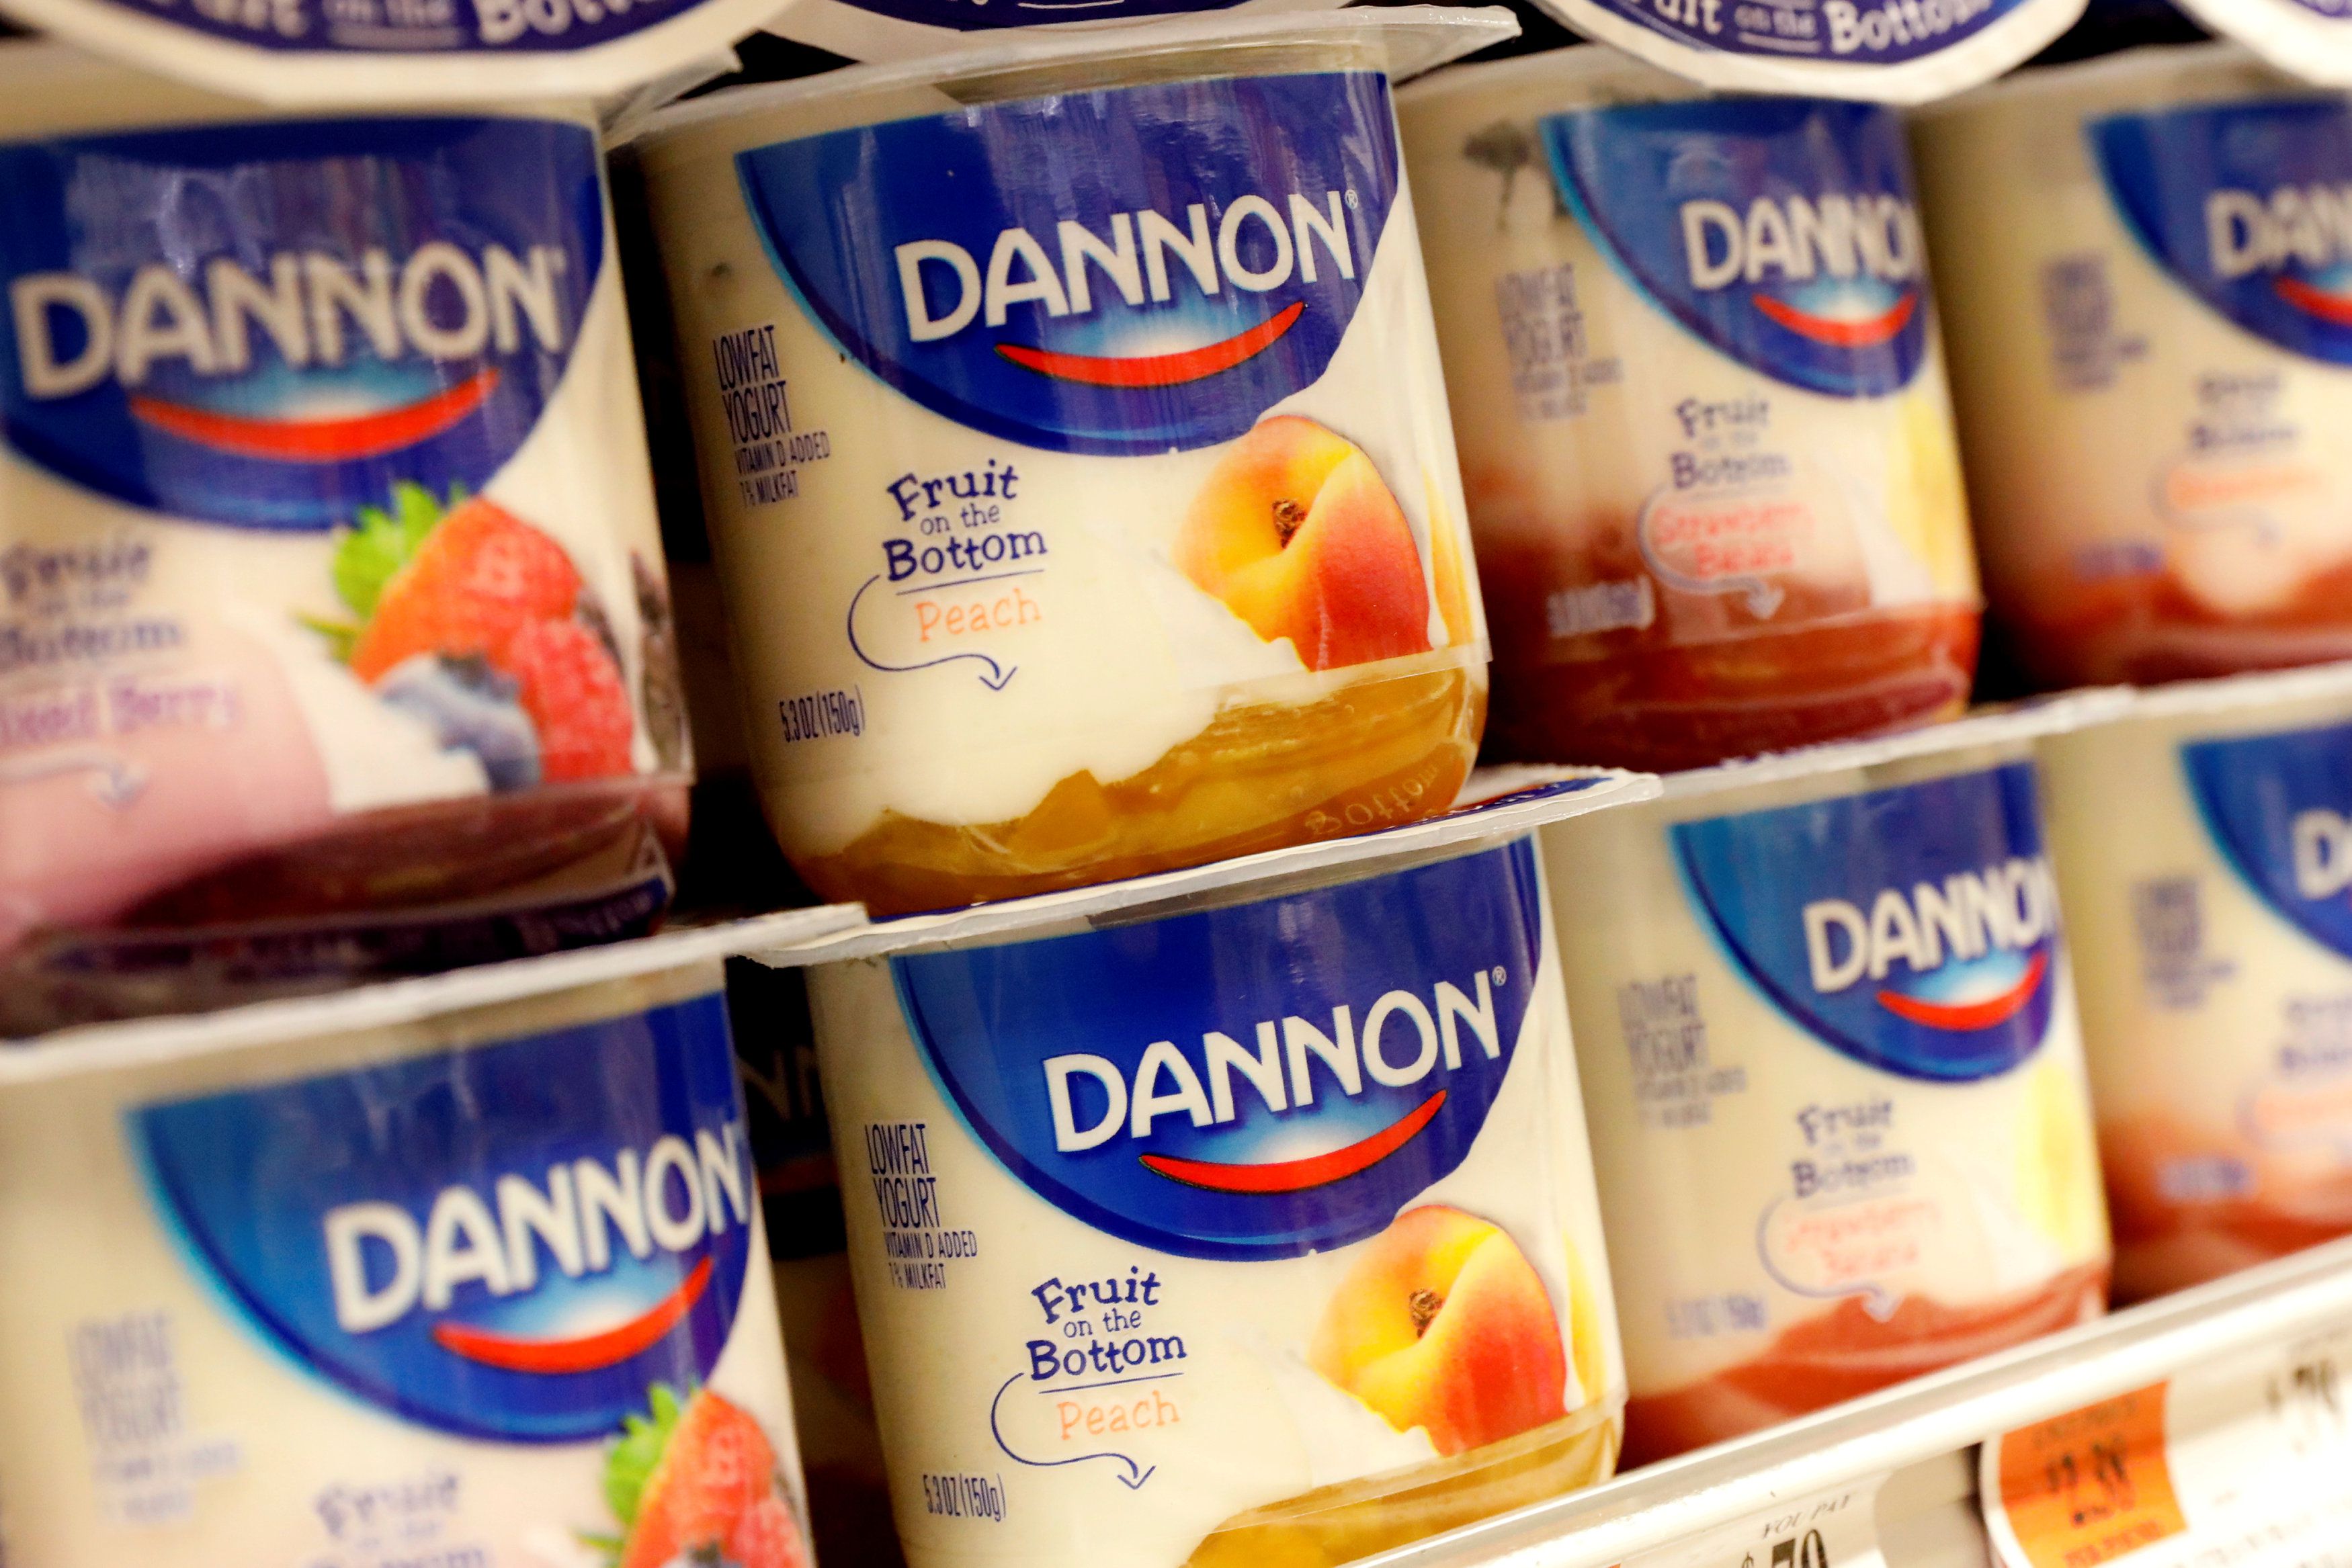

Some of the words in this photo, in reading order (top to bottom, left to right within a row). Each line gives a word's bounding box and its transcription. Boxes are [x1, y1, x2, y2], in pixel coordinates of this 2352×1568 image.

[713, 325, 780, 391] LOWFAT
[722, 380, 792, 444] YOGURT
[776, 440, 786, 467] D
[790, 431, 831, 464] ADDED
[886, 459, 1020, 521] Fruit
[920, 514, 951, 536] on
[960, 503, 1001, 529] the
[882, 530, 1048, 582] Bottom
[915, 589, 1042, 642] Peach
[864, 1124, 930, 1175] LOWFAT
[873, 1176, 940, 1229] YOGURT
[324, 1122, 750, 1336] DANNON
[884, 1231, 923, 1259] VITAMIN
[925, 1232, 934, 1259] D
[938, 1230, 978, 1258] ADDED
[904, 1262, 947, 1289] MILKFAT
[1032, 1266, 1162, 1324] Fruit
[1064, 1317, 1093, 1338] on
[1103, 1307, 1142, 1332] the
[1025, 1334, 1188, 1381] Bottom
[1056, 1390, 1181, 1440] Peach
